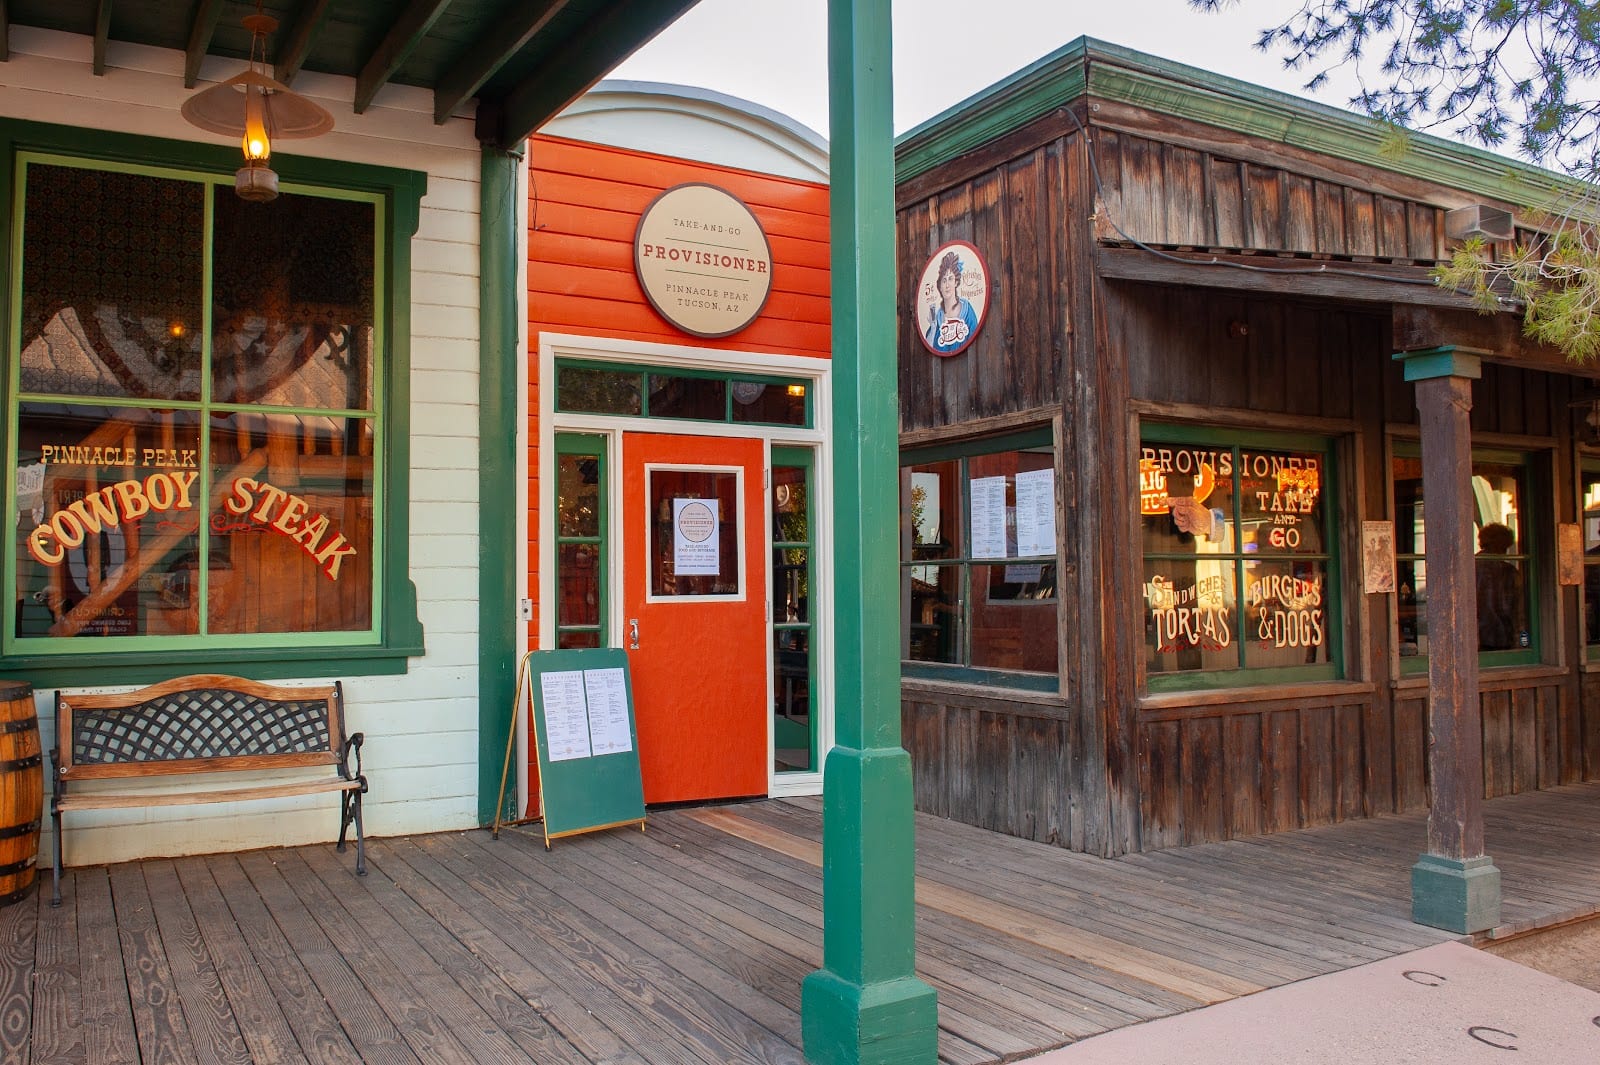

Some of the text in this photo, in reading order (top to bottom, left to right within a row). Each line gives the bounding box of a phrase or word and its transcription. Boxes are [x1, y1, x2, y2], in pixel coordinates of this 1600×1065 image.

[673, 218, 741, 235] TAKE-AND-GO
[643, 244, 767, 273] PROVISIONER
[665, 283, 749, 302] PINNACLE PEAK
[677, 299, 739, 312] TUCSON, AZ
[41, 445, 196, 467] PINNACLE PEAK
[1142, 448, 1319, 478] PROVISIONER
[1256, 491, 1312, 513] TAKE
[27, 472, 357, 581] COWBOY STEAK
[1270, 528, 1300, 548] GO
[1250, 575, 1321, 608] BURGERS
[1152, 608, 1230, 651] TORTAS
[1274, 609, 1322, 648] DOGS
